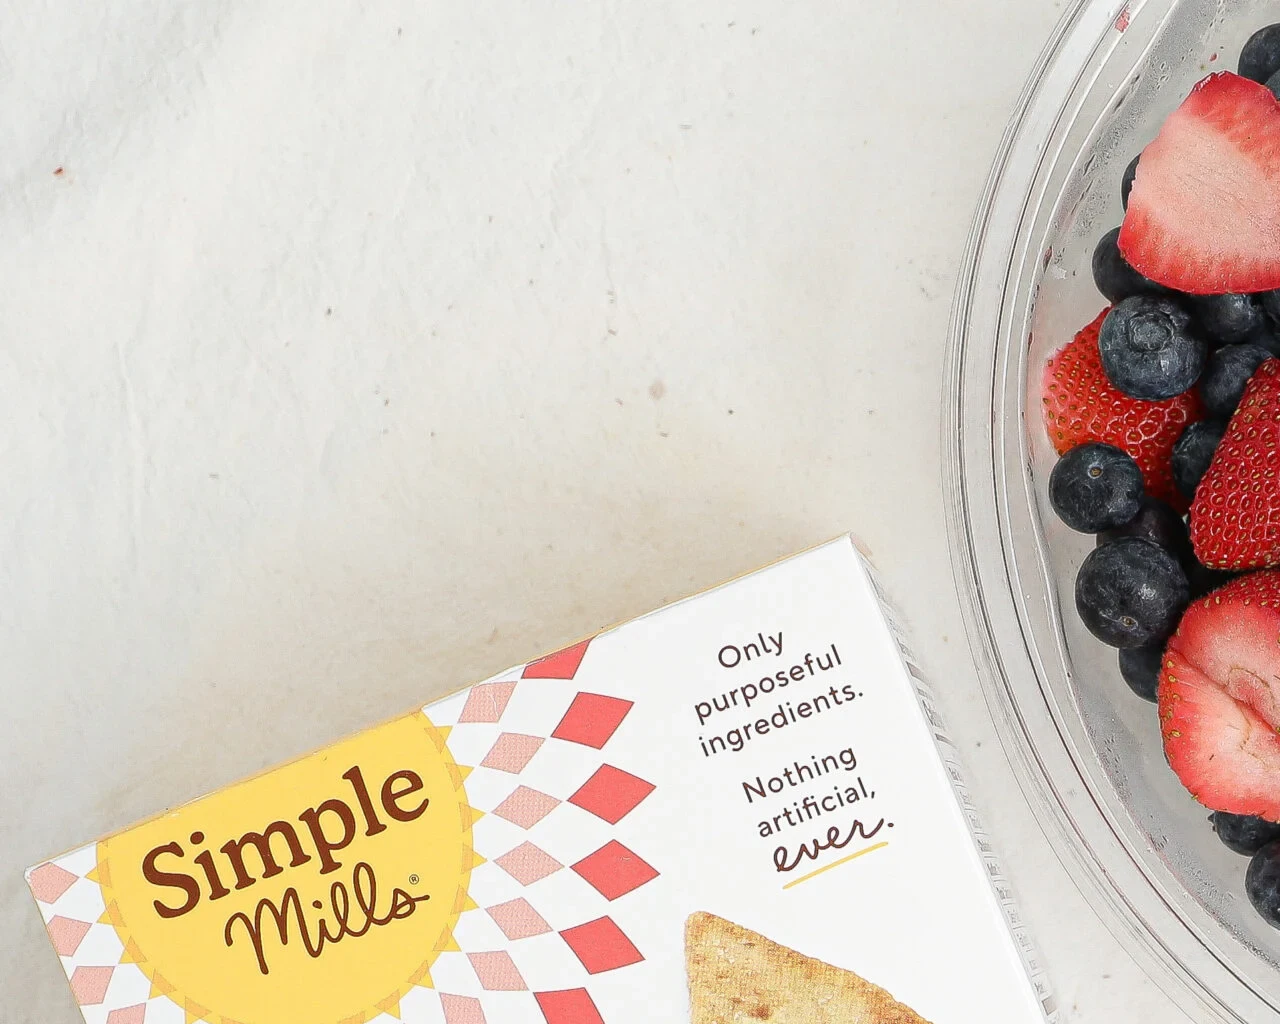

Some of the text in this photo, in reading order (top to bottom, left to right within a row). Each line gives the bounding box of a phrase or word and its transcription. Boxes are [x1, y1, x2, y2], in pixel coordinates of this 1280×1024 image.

[718, 632, 783, 668] Only
[694, 644, 842, 725] purposeful
[699, 684, 863, 757] ingredients.
[742, 748, 857, 803] Nothing
[757, 777, 875, 838] artificial,
[142, 765, 430, 919] Simple
[773, 818, 894, 872] ever.
[224, 862, 430, 975] Mills
